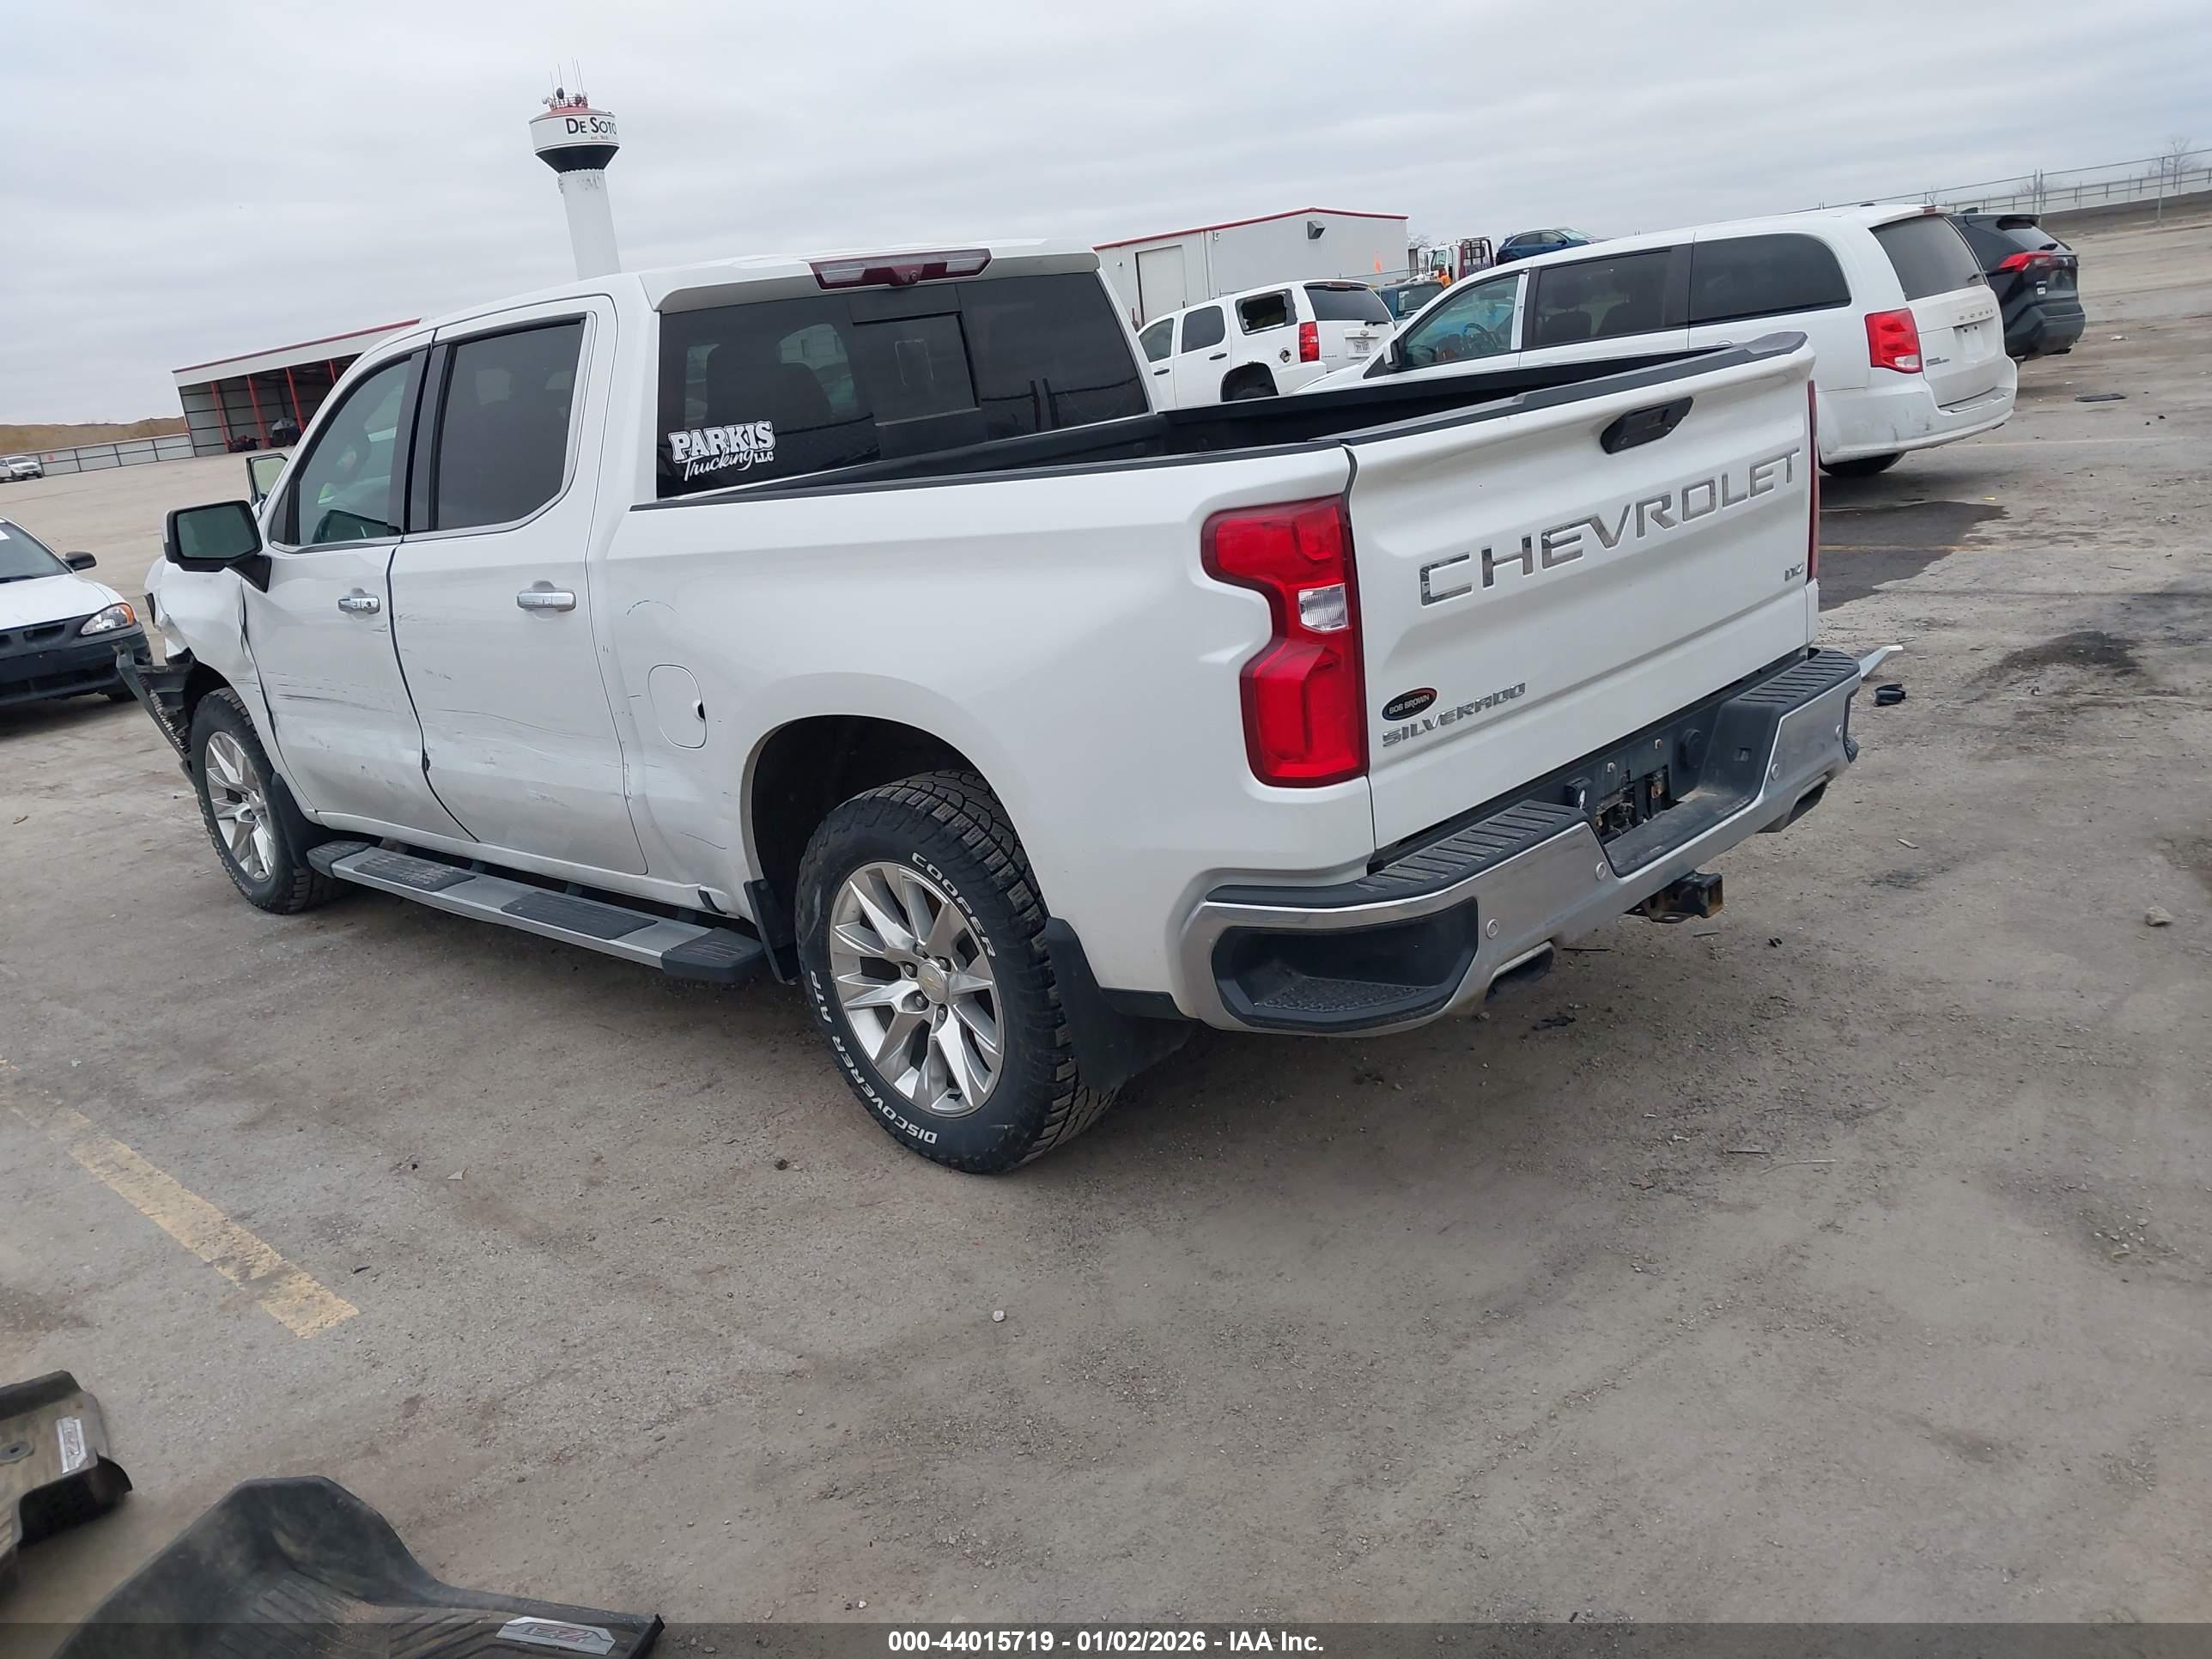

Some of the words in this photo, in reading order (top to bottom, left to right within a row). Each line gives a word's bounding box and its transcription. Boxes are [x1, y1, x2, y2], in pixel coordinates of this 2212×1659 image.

[668, 420, 775, 464] PARKIS
[679, 447, 754, 482] Trucking
[755, 451, 775, 464] LLC
[1419, 447, 1801, 606] CHEVROLET
[1382, 683, 1526, 747] SILVERADO
[1389, 702, 1404, 714] BOB
[1404, 693, 1430, 709] BROWN
[911, 852, 997, 957] COOPER
[810, 969, 833, 1024] ATP
[831, 1034, 938, 1145] DISCOVERER
